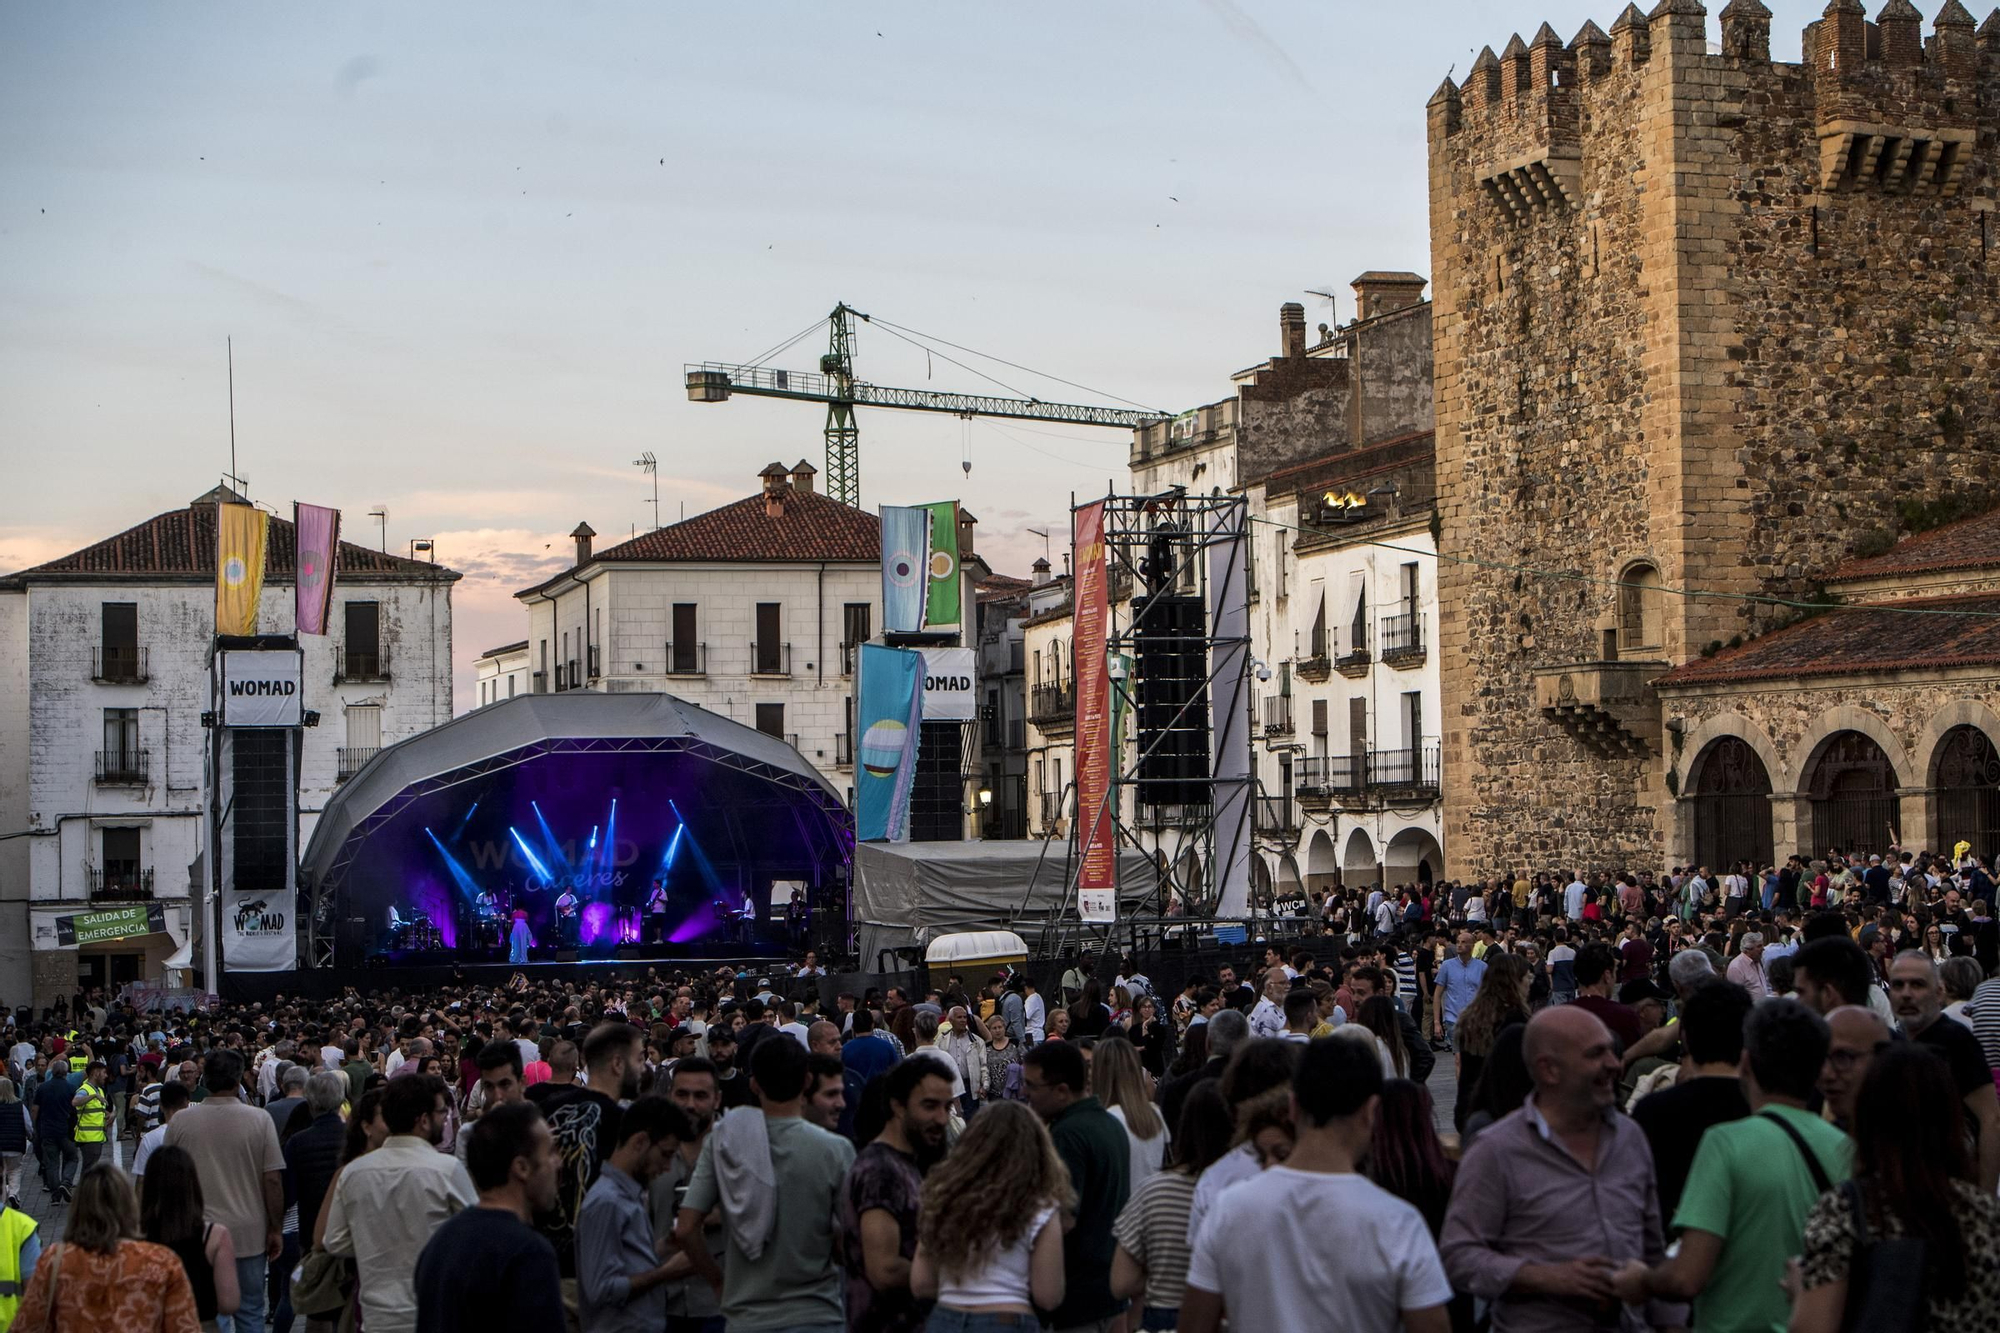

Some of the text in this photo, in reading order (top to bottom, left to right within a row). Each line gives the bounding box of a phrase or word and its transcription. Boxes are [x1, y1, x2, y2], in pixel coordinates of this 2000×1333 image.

[230, 681, 295, 696] WOMAD
[925, 676, 970, 691] OMAD
[1280, 900, 1300, 911] WC
[83, 911, 120, 925] SALIDA
[122, 909, 136, 919] DE
[78, 923, 146, 941] EMERGENCIA
